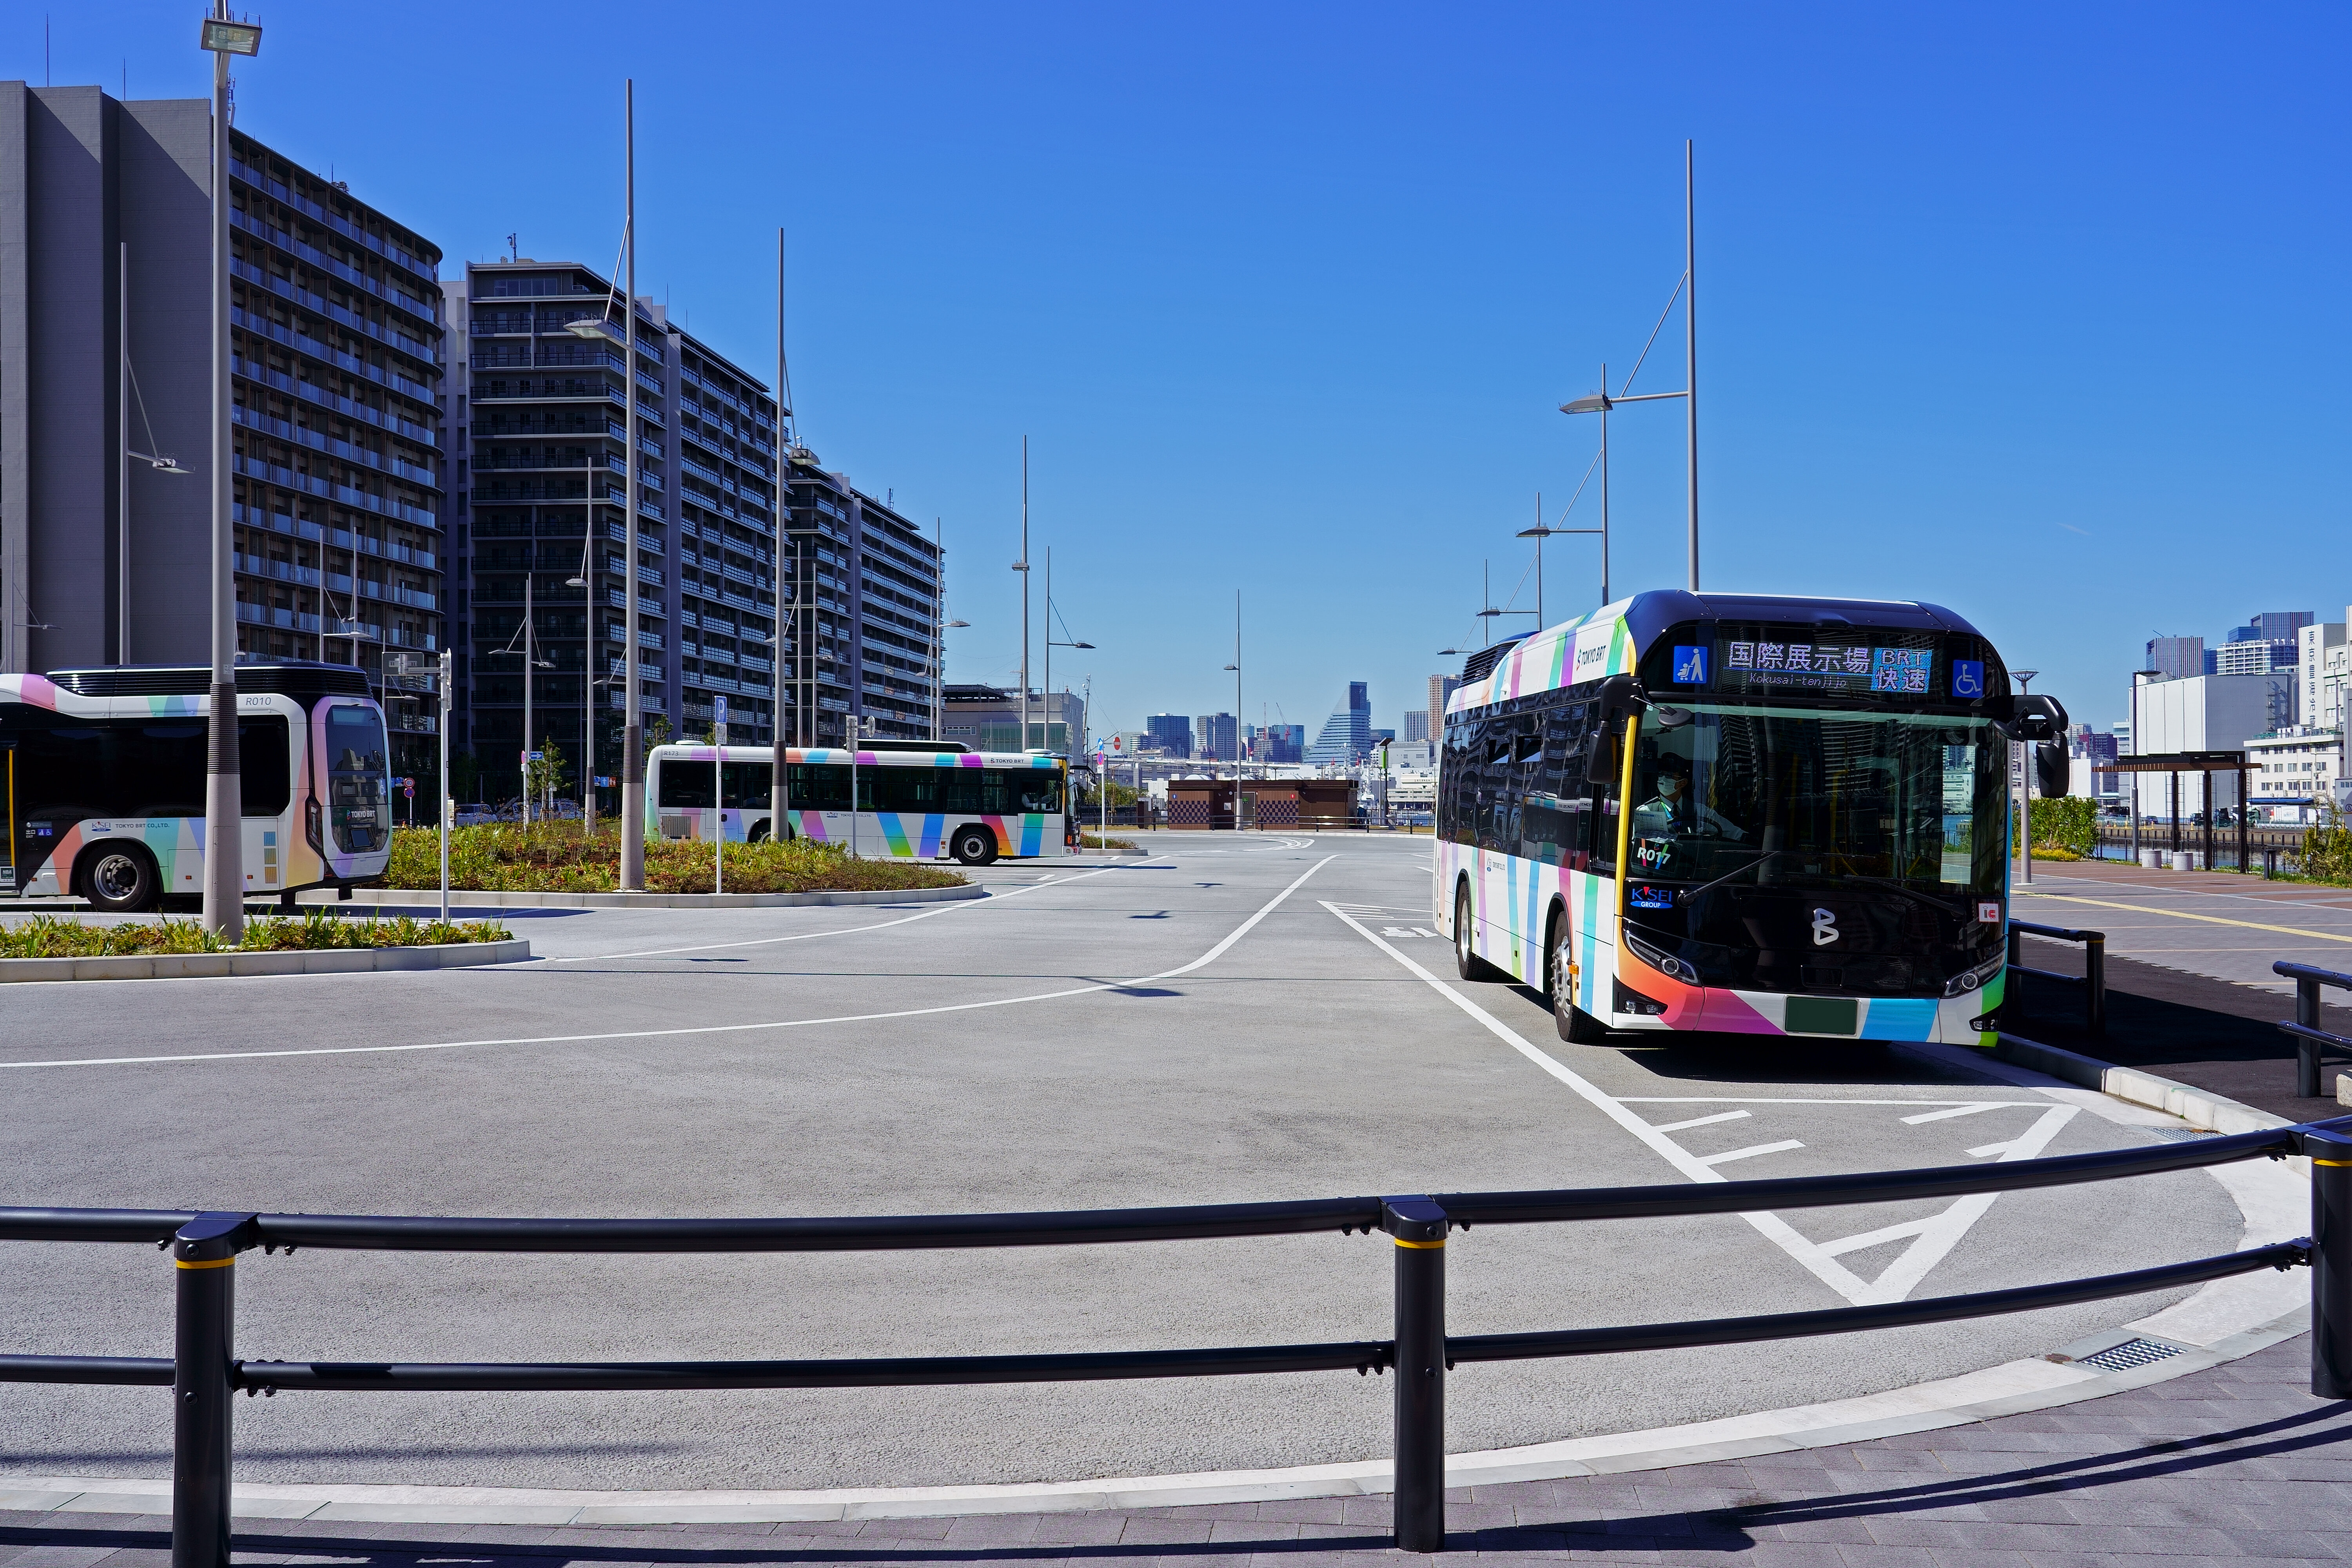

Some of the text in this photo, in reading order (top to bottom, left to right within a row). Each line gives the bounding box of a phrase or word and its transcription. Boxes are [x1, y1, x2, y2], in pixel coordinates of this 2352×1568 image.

[1581, 645, 1606, 666] TOKYO BRT
[1729, 642, 1870, 673] 国際展示場
[1882, 650, 1927, 666] BRT
[1749, 673, 1847, 689] Kokusai-tenjijo
[1875, 666, 1926, 691] 快速
[245, 697, 271, 705] R010
[718, 699, 725, 720] P
[1637, 847, 1671, 864] R017
